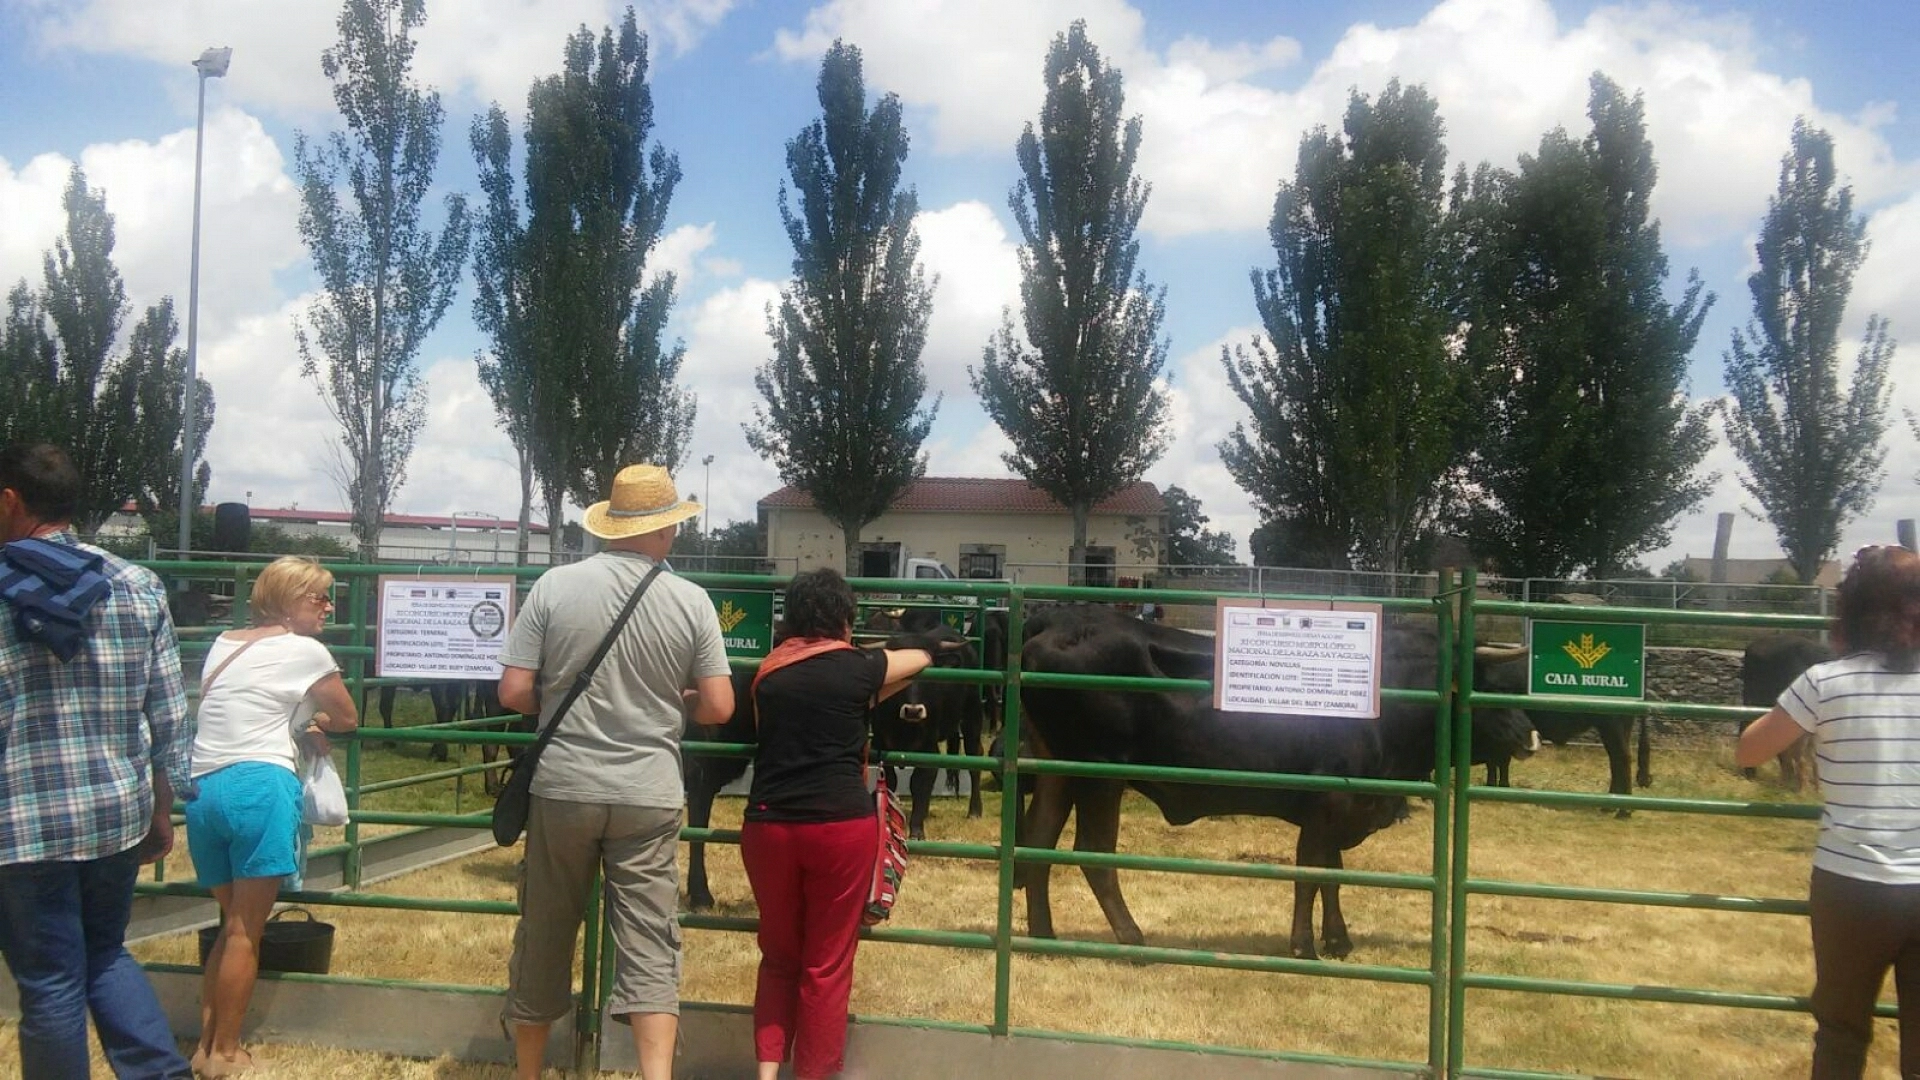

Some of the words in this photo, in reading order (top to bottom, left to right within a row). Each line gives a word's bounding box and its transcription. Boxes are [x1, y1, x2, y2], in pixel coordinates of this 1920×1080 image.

[722, 637, 760, 649] RURAL
[1249, 639, 1295, 648] CONCURSO
[1229, 647, 1270, 656] NACIONAL
[1272, 648, 1282, 656] DE
[1296, 650, 1319, 658] RAZA
[1319, 651, 1371, 660] SAYAGUESA
[1229, 659, 1267, 667] CATEGORÍA:
[1544, 672, 1578, 685] CAJA
[1581, 674, 1629, 688] RURAL
[1274, 685, 1305, 693] ANTONIO
[1228, 696, 1266, 704] LOCALIDAD:
[1268, 697, 1290, 705] VILLAR
[1324, 701, 1358, 709] (ZAMORA)
